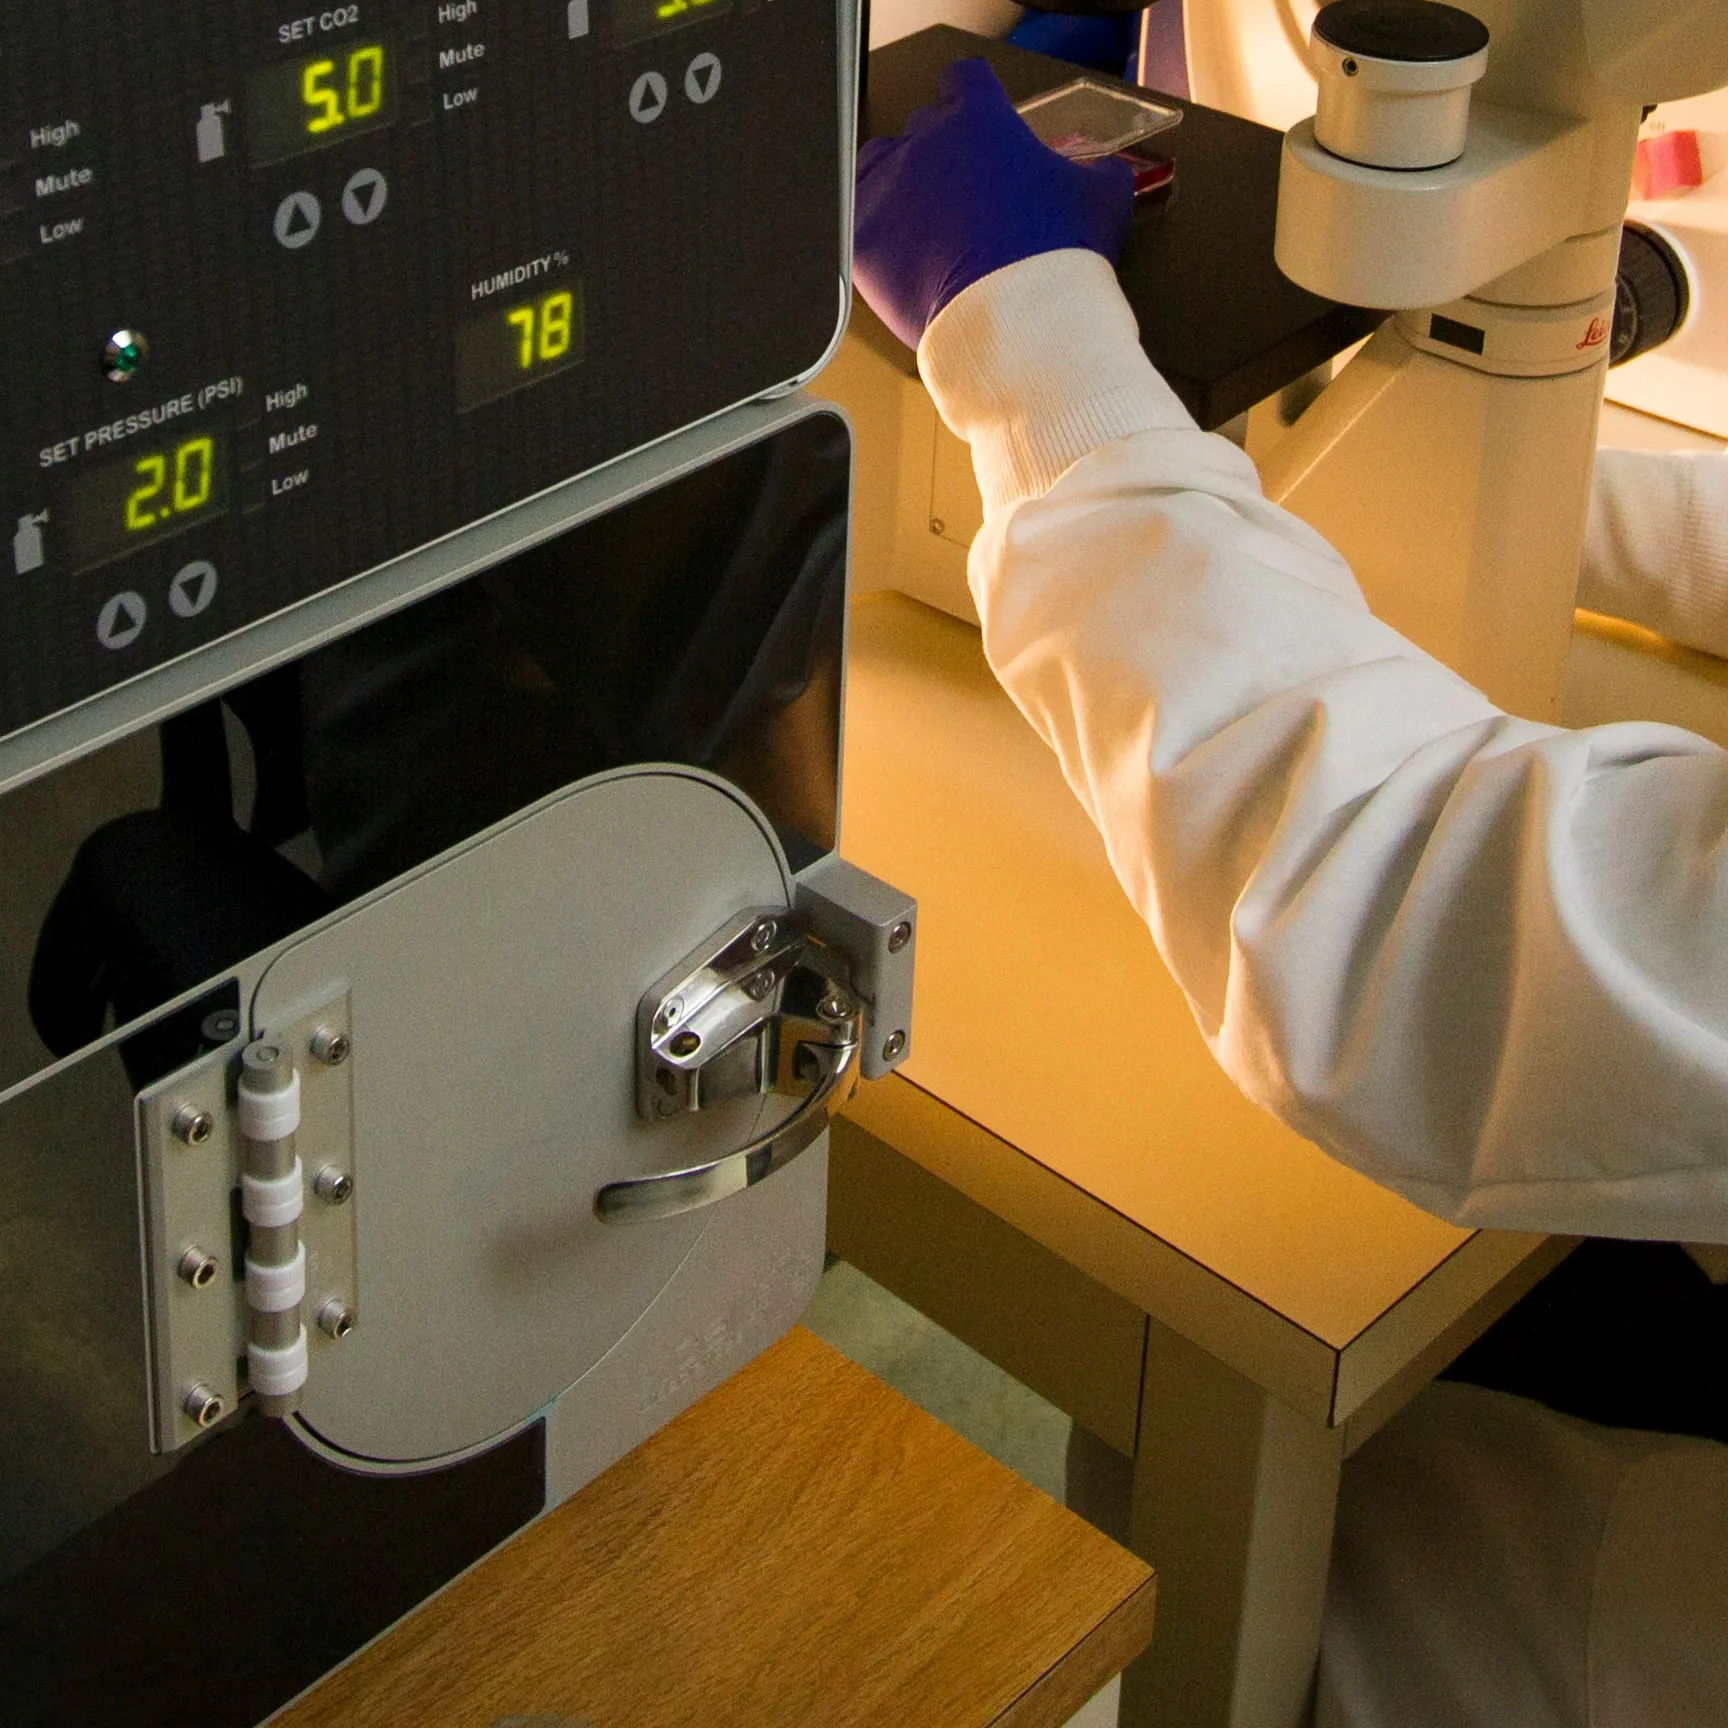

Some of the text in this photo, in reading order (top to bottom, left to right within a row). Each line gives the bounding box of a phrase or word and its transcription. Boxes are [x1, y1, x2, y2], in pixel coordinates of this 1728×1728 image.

[277, 2, 360, 46] SET CO2
[437, 40, 485, 70] Mute
[442, 84, 479, 112] Low
[29, 115, 81, 151] High
[33, 163, 94, 200] Mute
[38, 213, 84, 245] Low
[469, 248, 570, 303] HUMIDITY %
[505, 290, 574, 370] 78
[264, 380, 310, 414] High
[37, 374, 246, 470] SET PRESSURE (PSI)
[266, 419, 319, 455] Mute
[124, 434, 214, 533] 2.0
[270, 465, 311, 499] Low
